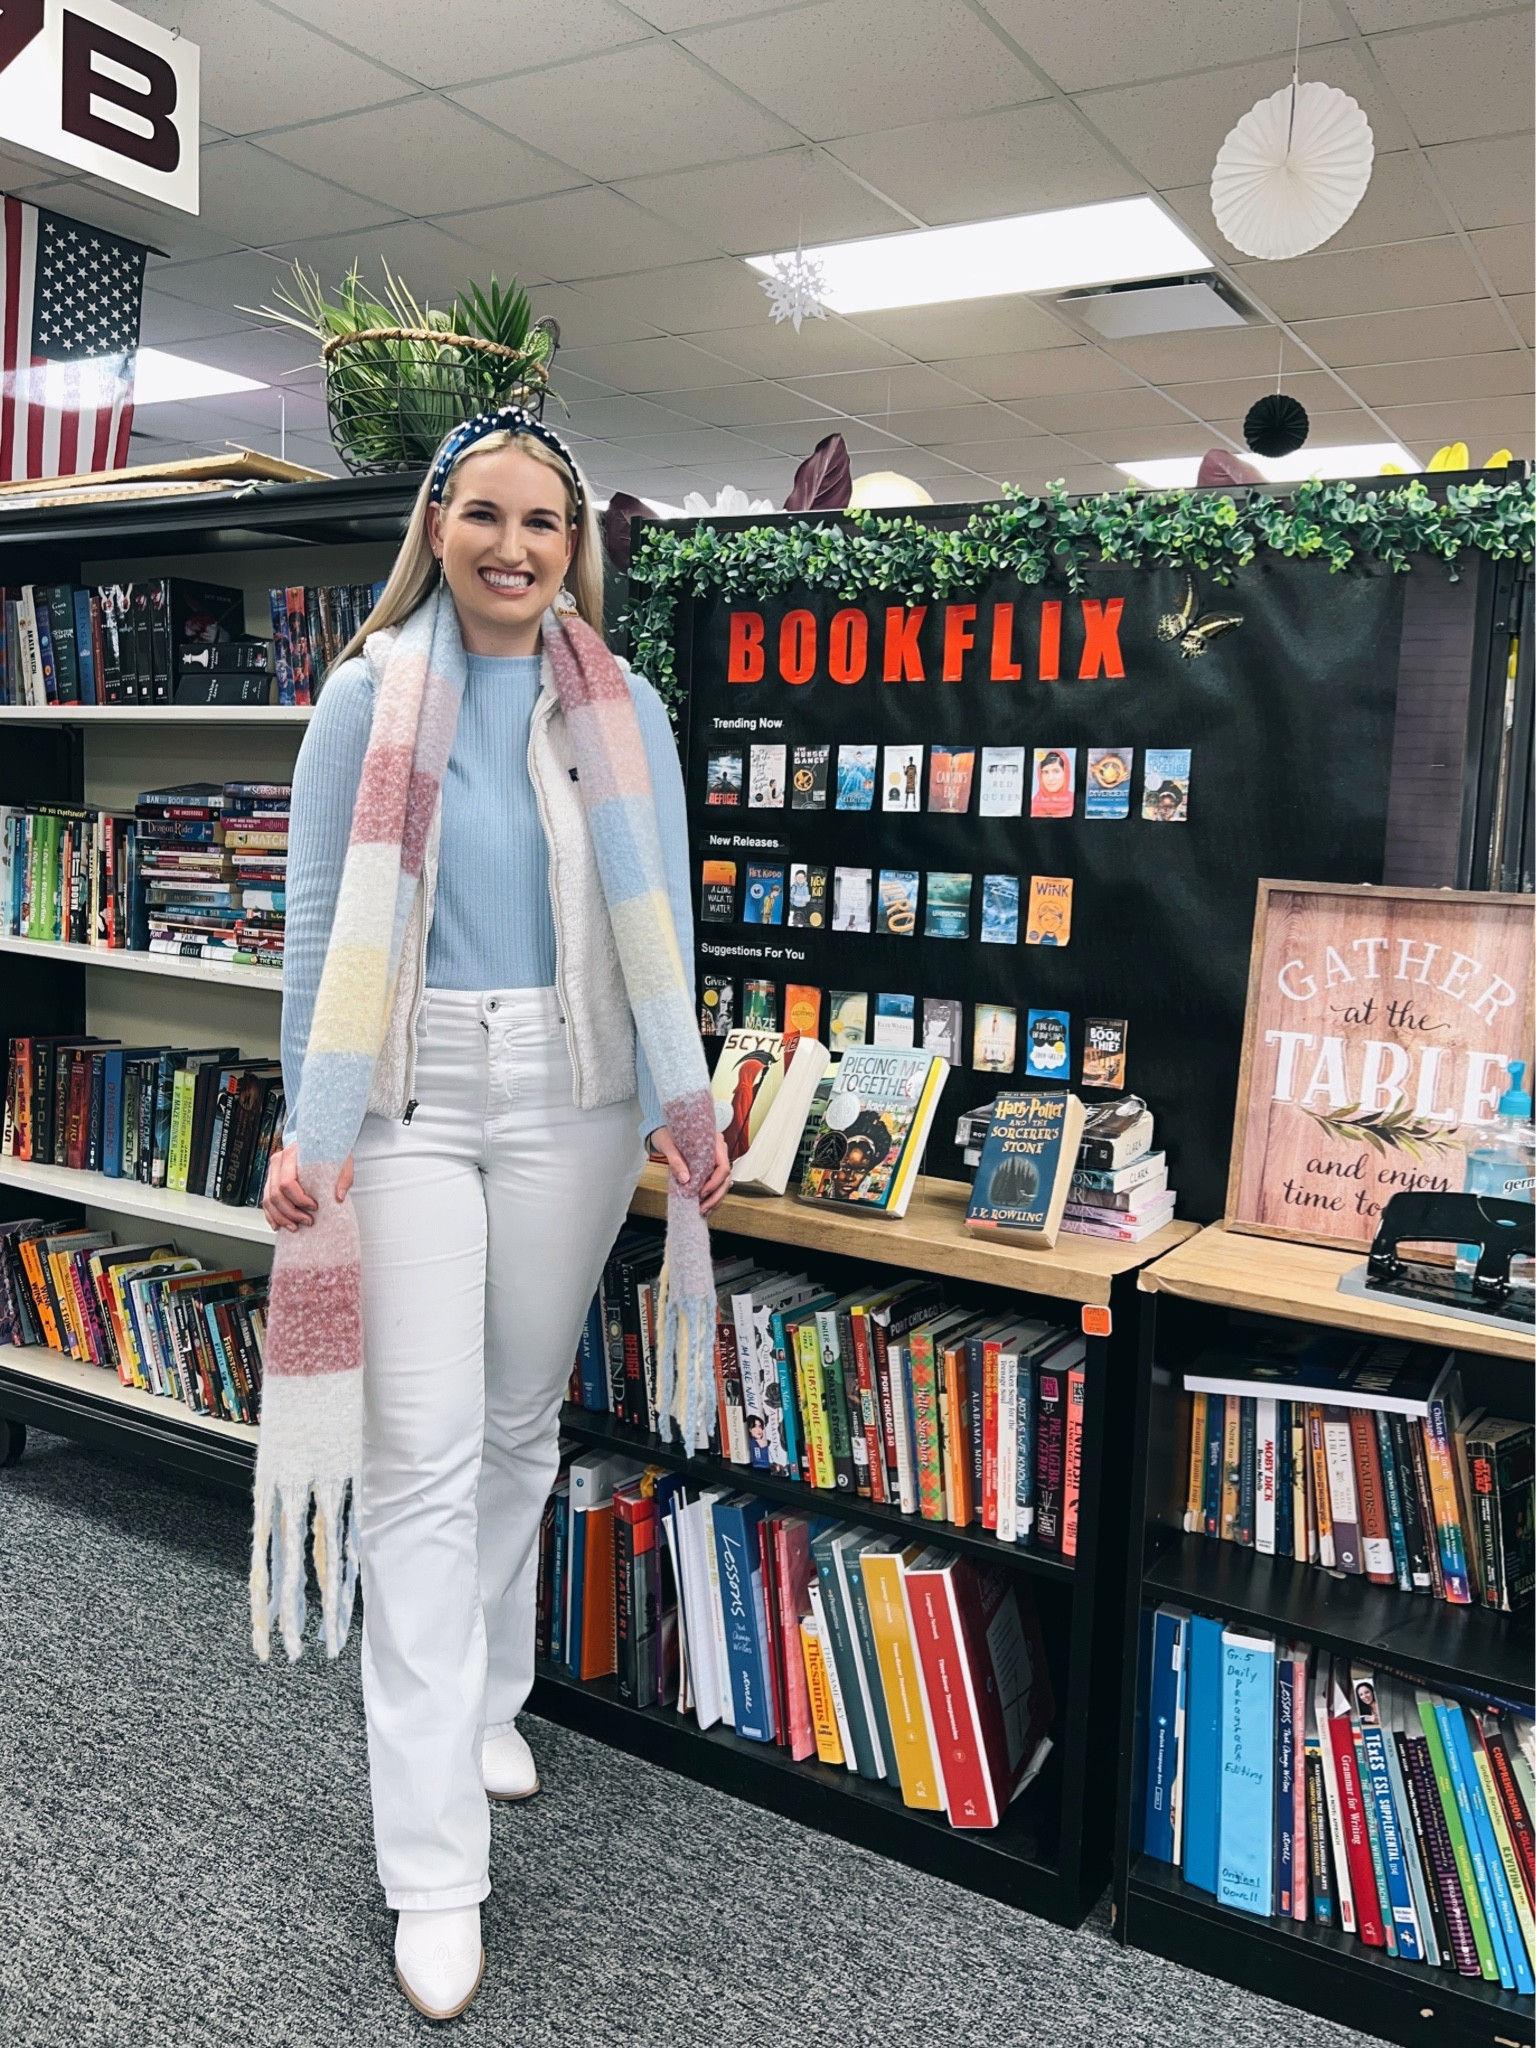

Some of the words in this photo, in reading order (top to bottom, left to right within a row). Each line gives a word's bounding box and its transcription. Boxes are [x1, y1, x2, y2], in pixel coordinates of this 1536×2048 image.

[62, 9, 180, 173] B
[728, 597, 1126, 686] BOOKFLIX
[29, 652, 37, 675] WITCH
[713, 717, 757, 730] Trending
[759, 717, 783, 728] Now
[794, 750, 828, 758] HUNGER
[1147, 764, 1189, 774] TOGETHER
[982, 793, 1020, 801] QUEEN
[992, 780, 1014, 788] RED
[146, 795, 159, 804] BAN
[169, 796, 184, 804] BOOK
[709, 793, 739, 805] REFUGEE
[148, 821, 174, 834] Dragon
[175, 821, 194, 836] Rider
[709, 835, 731, 845] New
[733, 836, 779, 848] Releases
[810, 875, 826, 887] NEW
[812, 886, 824, 897] KID
[1036, 882, 1069, 898] WINK
[709, 904, 731, 913] WATER
[181, 933, 198, 943] FAKE
[181, 944, 200, 956] elixir
[701, 943, 762, 957] Suggestions
[764, 947, 783, 958] For
[785, 948, 805, 960] You
[704, 975, 727, 986] GIVER
[1277, 936, 1518, 1026] GATHER
[745, 1018, 776, 1030] MAZE
[1330, 998, 1377, 1026] at
[1387, 1000, 1450, 1031] the
[725, 1034, 800, 1054] SCYTHE
[1090, 1029, 1121, 1042] BOOK
[1092, 1039, 1120, 1052] THIEF
[38, 1052, 47, 1091] THE
[843, 1056, 902, 1077] PIECING
[902, 1059, 925, 1074] ME
[1265, 1030, 1511, 1126] TABLE
[840, 1073, 907, 1098] TOGETHE
[106, 1082, 116, 1157] DIVERGENT
[173, 1099, 181, 1120] MAZE
[994, 1100, 1030, 1121] Harry
[1028, 1098, 1065, 1123] Potter
[1032, 1119, 1048, 1127] THE
[37, 1097, 46, 1150] TOLL
[125, 1093, 136, 1167] INSURGENT
[170, 1121, 179, 1148] RUNNER
[990, 1126, 1060, 1141] SORCERER'S
[220, 1129, 228, 1156] RUNNER
[1001, 1141, 1045, 1154] STONE
[229, 1139, 244, 1181] DEEPER
[1306, 1153, 1369, 1180] and
[1378, 1167, 1452, 1193] enjoy
[1283, 1178, 1346, 1211] time
[990, 1209, 1044, 1223] ROWLING
[44, 1265, 52, 1284] LOWRY
[32, 1282, 42, 1306] WINK
[40, 1284, 51, 1309] WINK
[83, 1288, 98, 1323] SPIN
[821, 1316, 831, 1345] FOWLER
[890, 1322, 907, 1336] PORT
[908, 1308, 938, 1327] CHICAGO
[607, 1306, 626, 1402] FOUND
[624, 1333, 641, 1380] REFUGEE
[719, 1340, 728, 1376] FRANK
[740, 1345, 750, 1357] AM
[875, 1325, 885, 1364] SHEINKIN
[223, 1336, 242, 1389] FIRESTORM!
[239, 1348, 253, 1389] DARKNESS
[728, 1344, 737, 1374] ANNE
[742, 1360, 754, 1385] HERE
[856, 1341, 866, 1377] Strategies
[807, 1370, 817, 1393] FIRST
[880, 1374, 889, 1398] PORT
[745, 1386, 758, 1410] NOW
[811, 1394, 821, 1428] RULE
[825, 1369, 836, 1406] SNAKES
[831, 1414, 842, 1450] STONES
[917, 1387, 929, 1415] Hello,
[882, 1398, 893, 1435] CHICAGO
[972, 1390, 982, 1445] ALABAMA
[814, 1436, 825, 1465] PUNK
[865, 1431, 873, 1445] Jay
[886, 1436, 896, 1447] 50
[918, 1417, 930, 1467] Sunshine
[1067, 1420, 1075, 1465] LANGUAGE
[868, 1448, 878, 1485] McGraw
[974, 1449, 983, 1479] MOON
[1049, 1417, 1061, 1493] PRE-ALGEBRA
[1264, 1439, 1274, 1474] MOBY
[1264, 1476, 1274, 1502] DICK
[1473, 1458, 1487, 1493] WARS
[1482, 1460, 1492, 1494] STAR
[617, 1529, 629, 1640] LITERATURE
[925, 1592, 935, 1619] Language
[930, 1619, 940, 1640] Network
[824, 1647, 834, 1669] THIS
[1226, 1649, 1241, 1661] Gr.
[1243, 1653, 1253, 1661] 5
[807, 1639, 825, 1722] Thesaurus
[828, 1671, 840, 1698] SAME
[1226, 1664, 1258, 1682] Daily
[835, 1701, 846, 1720] SKY
[938, 1658, 950, 1693] Time-Saver
[944, 1693, 959, 1741] Transparencies
[1224, 1764, 1264, 1784] Editing
[1282, 1769, 1290, 1794] Writers
[1340, 1754, 1354, 1798] Grammar
[1373, 1776, 1386, 1797] ESL
[1492, 1746, 1523, 1821] COMPREHENSION
[1347, 1798, 1356, 1811] for
[1348, 1812, 1362, 1846] Writing
[1379, 1799, 1400, 1862] SUPPLEMENTAL
[1222, 1867, 1261, 1886] Original
[1370, 1845, 1382, 1877] WRITING
[1376, 1878, 1387, 1909] TEACHER
[1502, 1846, 1521, 1890] REVIVING
[1457, 1845, 1471, 1883] Vocabulary
[1466, 1884, 1480, 1919] Workshop
[1490, 1860, 1505, 1898] Vocabulary
[1501, 1899, 1515, 1934] Workshop
